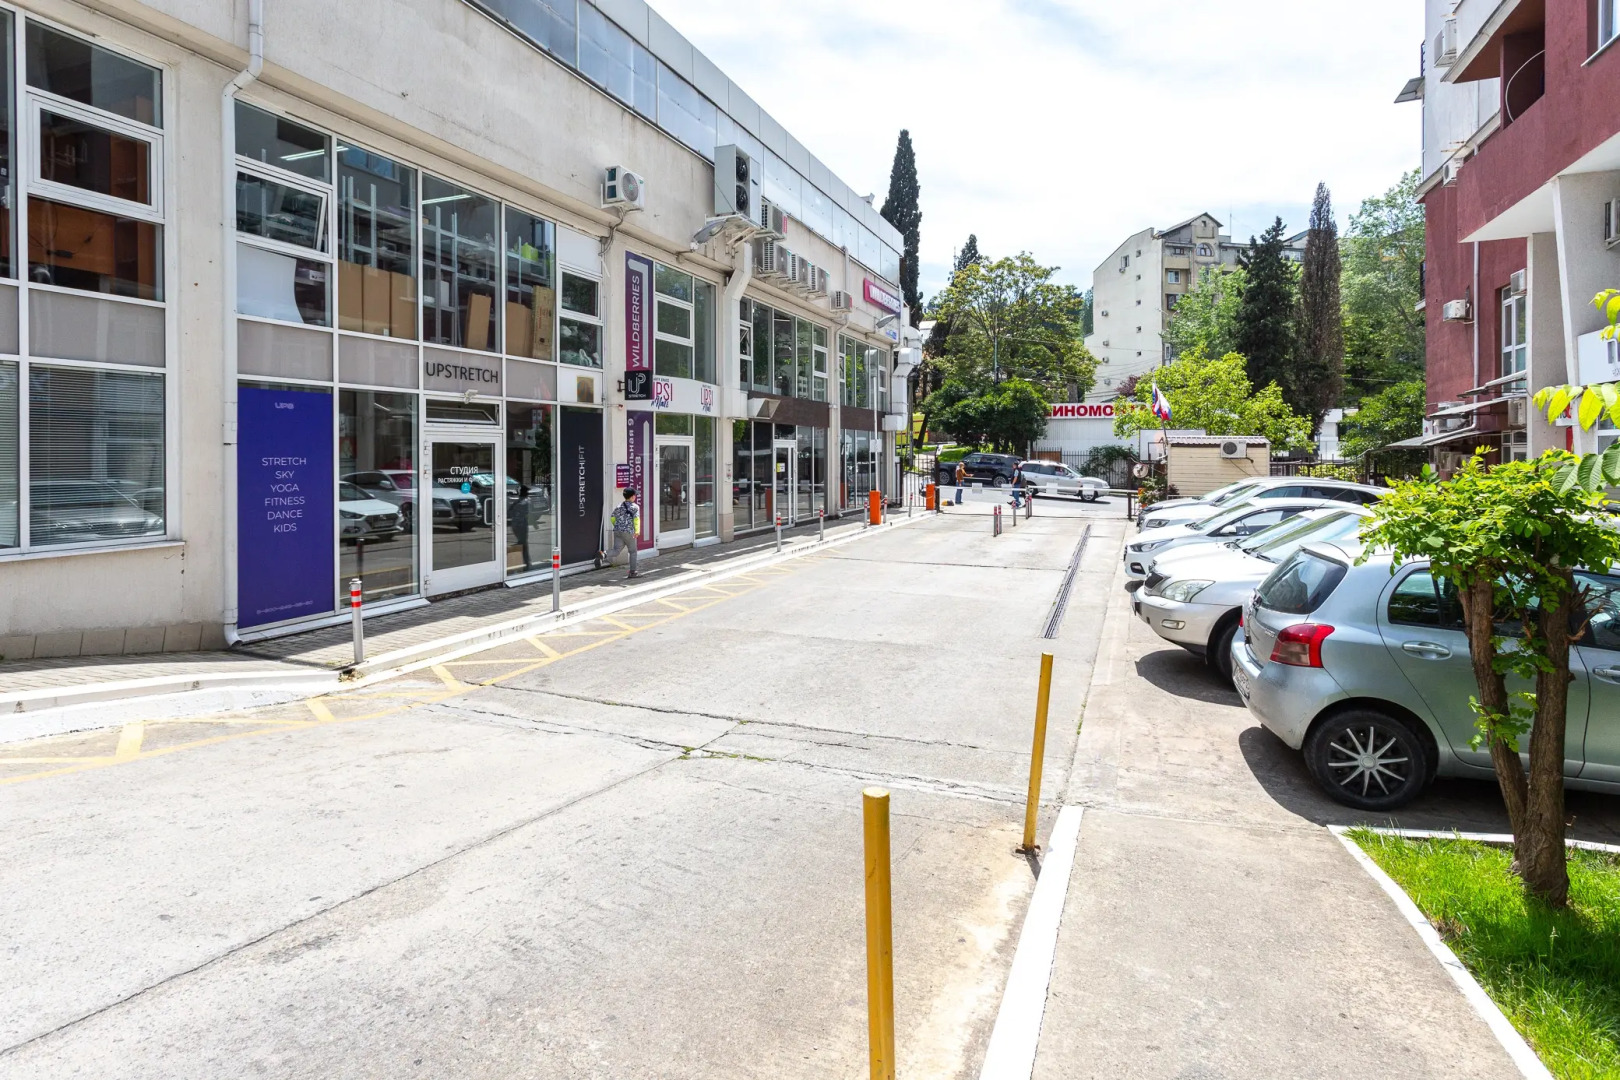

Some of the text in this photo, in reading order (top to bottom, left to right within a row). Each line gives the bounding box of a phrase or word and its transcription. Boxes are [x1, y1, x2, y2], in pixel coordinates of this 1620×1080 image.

[631, 274, 641, 369] WILDBERRIES
[425, 361, 499, 384] UPSTRETCH
[1044, 404, 1147, 417] ИНОМО
[627, 417, 635, 427] 9
[261, 457, 307, 466] STRETCH
[275, 470, 295, 480] SKY
[450, 466, 479, 476] СТУДИЯ
[270, 483, 300, 493] YOGA
[264, 496, 306, 507] FITNESS
[267, 510, 303, 520] DANCE
[273, 523, 297, 533] KIDS
